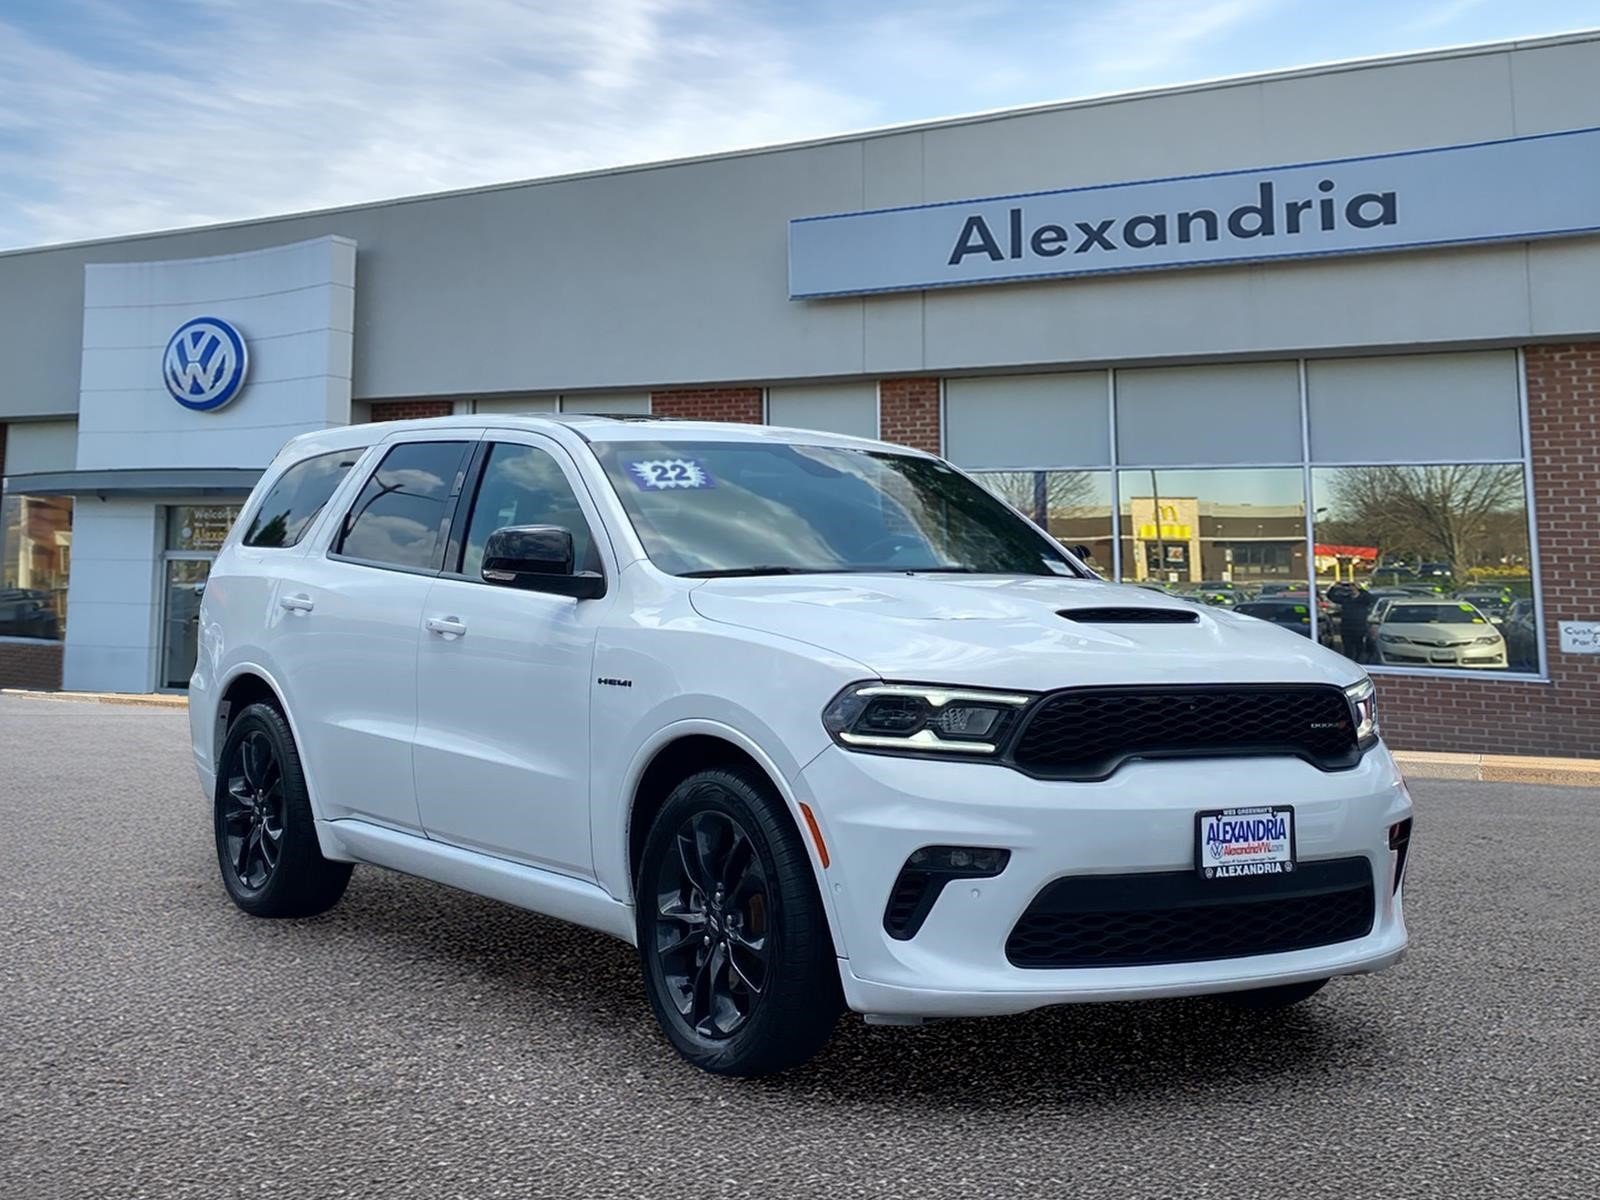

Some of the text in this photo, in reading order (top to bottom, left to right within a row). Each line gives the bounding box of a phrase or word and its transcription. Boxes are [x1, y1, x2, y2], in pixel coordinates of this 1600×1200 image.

[948, 180, 1398, 265] Alexandria
[167, 325, 237, 402] VW
[651, 464, 692, 481] 22
[597, 677, 632, 687] HEMI
[1206, 817, 1287, 845] ALEXANDRIA
[1216, 862, 1282, 878] ALEXANDRIA
